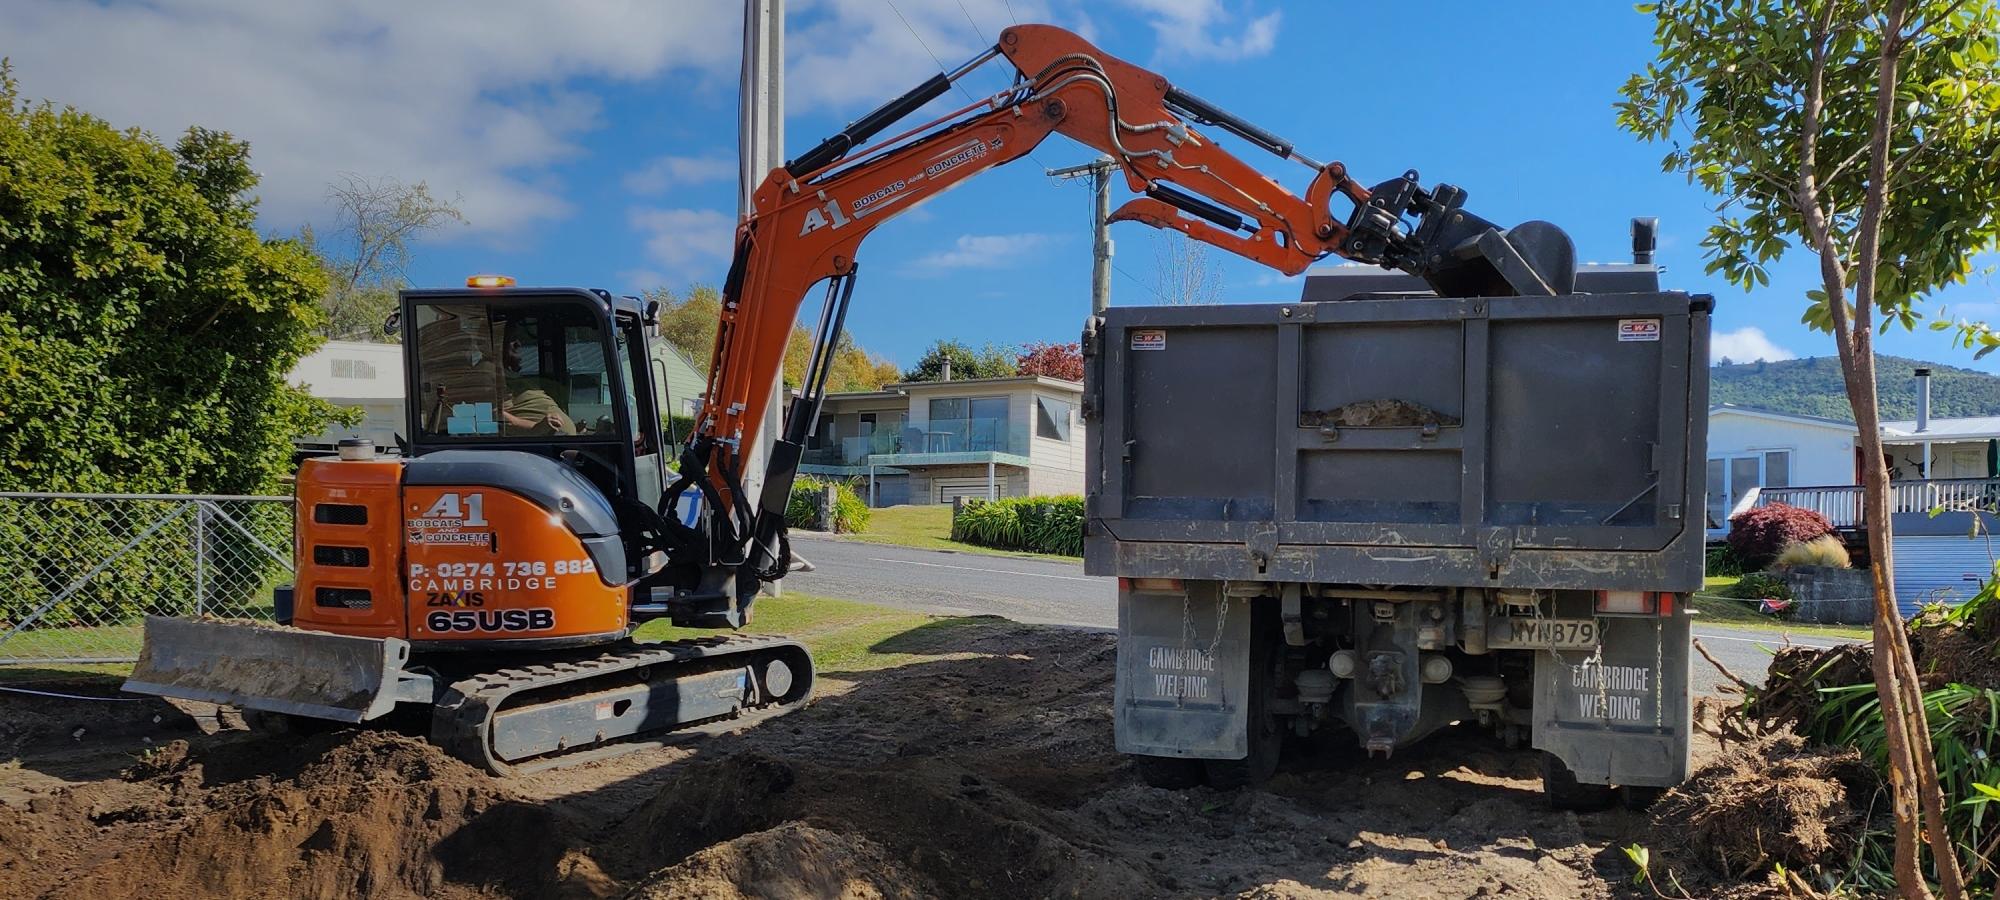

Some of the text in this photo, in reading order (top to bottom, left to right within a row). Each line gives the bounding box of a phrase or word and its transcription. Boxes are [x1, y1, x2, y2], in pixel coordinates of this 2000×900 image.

[799, 198, 851, 237] A1
[852, 180, 906, 210] BOBCATS
[925, 142, 987, 176] CONCRETE
[422, 493, 489, 527] A1
[407, 519, 463, 528] BOBCATS
[425, 533, 490, 543] CONCRETE
[410, 558, 595, 578] P: 0274 736 882
[410, 577, 557, 591] CAMBRIDGE
[426, 588, 484, 608] ZAXIS
[426, 608, 555, 633] 65USB
[1510, 622, 1594, 643] MYN879
[1149, 647, 1215, 671] CAMBRIDGE
[1155, 674, 1208, 698] WELDING
[1572, 665, 1649, 692] CAMBRIDGE
